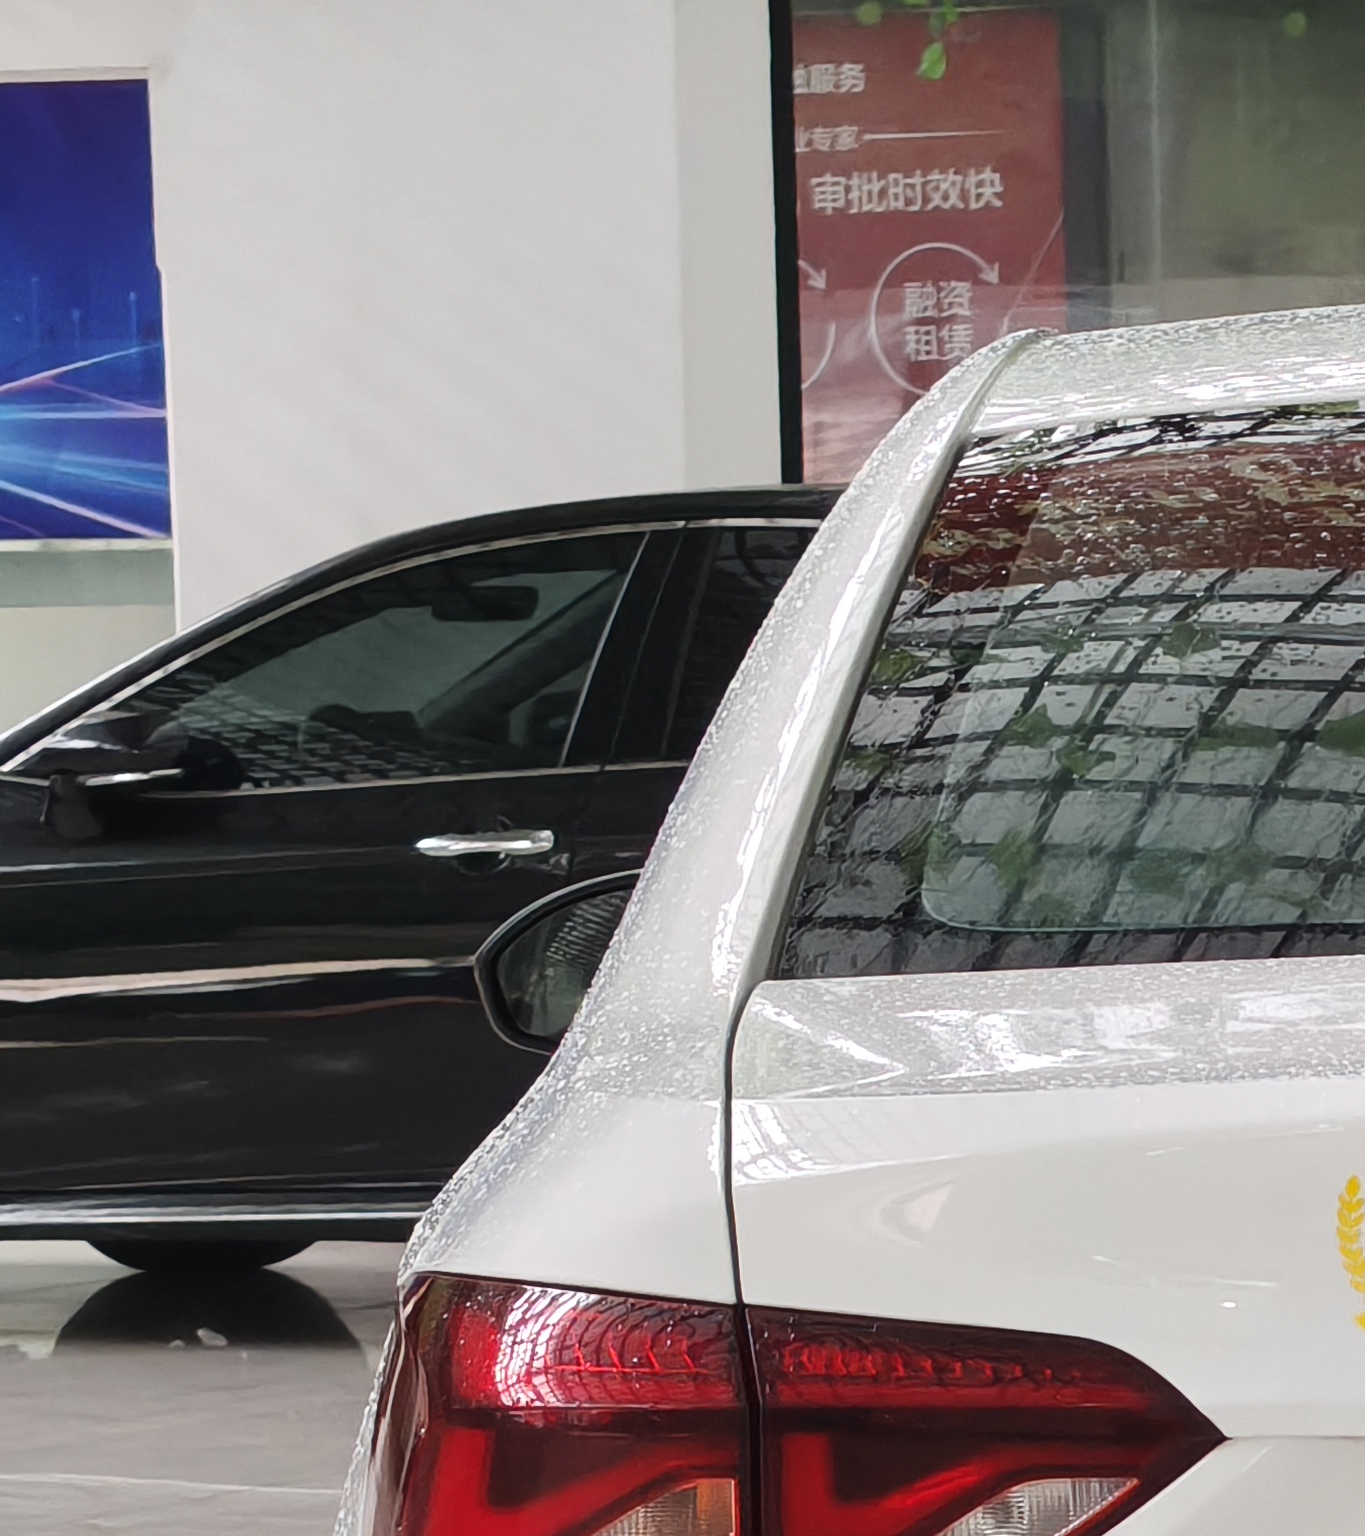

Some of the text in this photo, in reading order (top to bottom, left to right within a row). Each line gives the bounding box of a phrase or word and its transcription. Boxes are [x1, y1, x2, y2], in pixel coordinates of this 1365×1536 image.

[810, 166, 1004, 215] 审批时效快
[903, 280, 974, 318] 融资
[903, 324, 974, 361] 租赁
